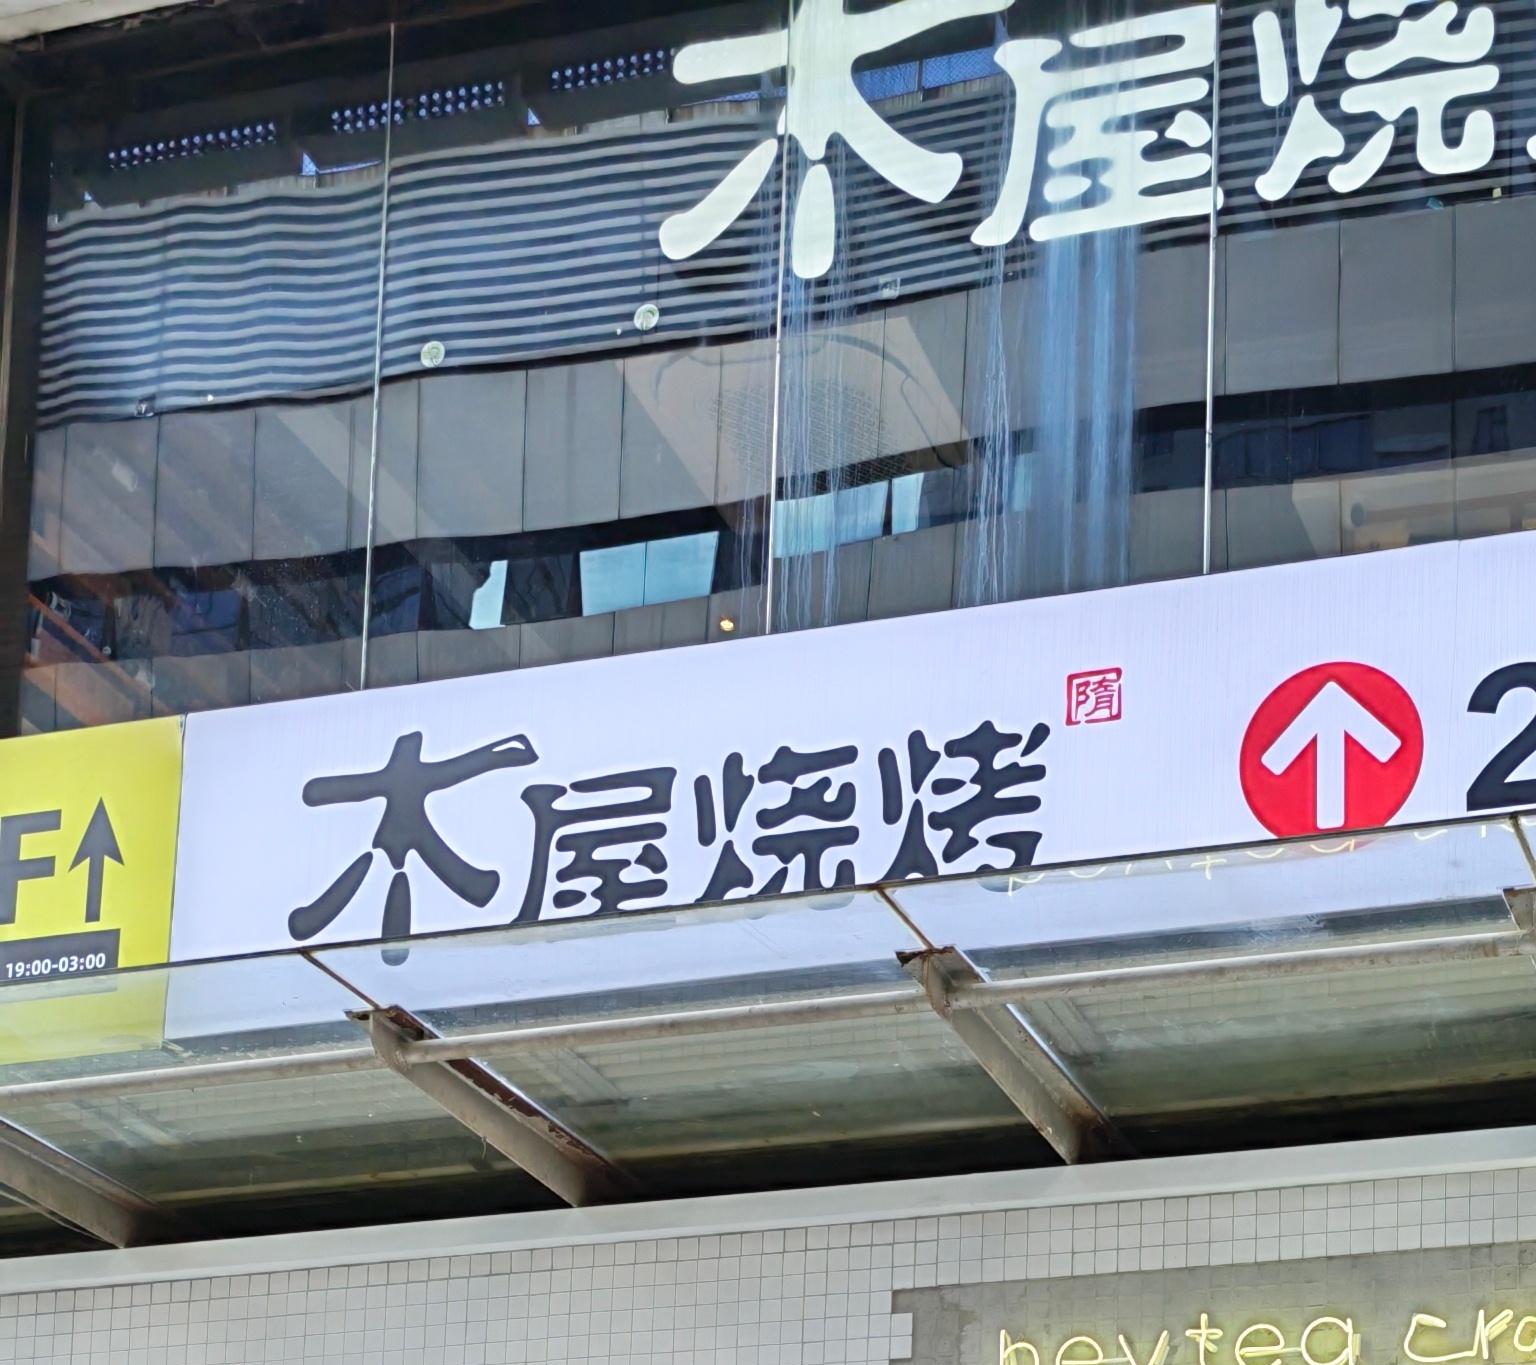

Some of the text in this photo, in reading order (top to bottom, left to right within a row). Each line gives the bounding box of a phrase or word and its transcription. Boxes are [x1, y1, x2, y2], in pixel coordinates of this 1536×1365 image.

[0, 809, 62, 926] F
[289, 722, 1049, 965] 木屋烧烤
[5, 952, 107, 979] 19:00-03:00
